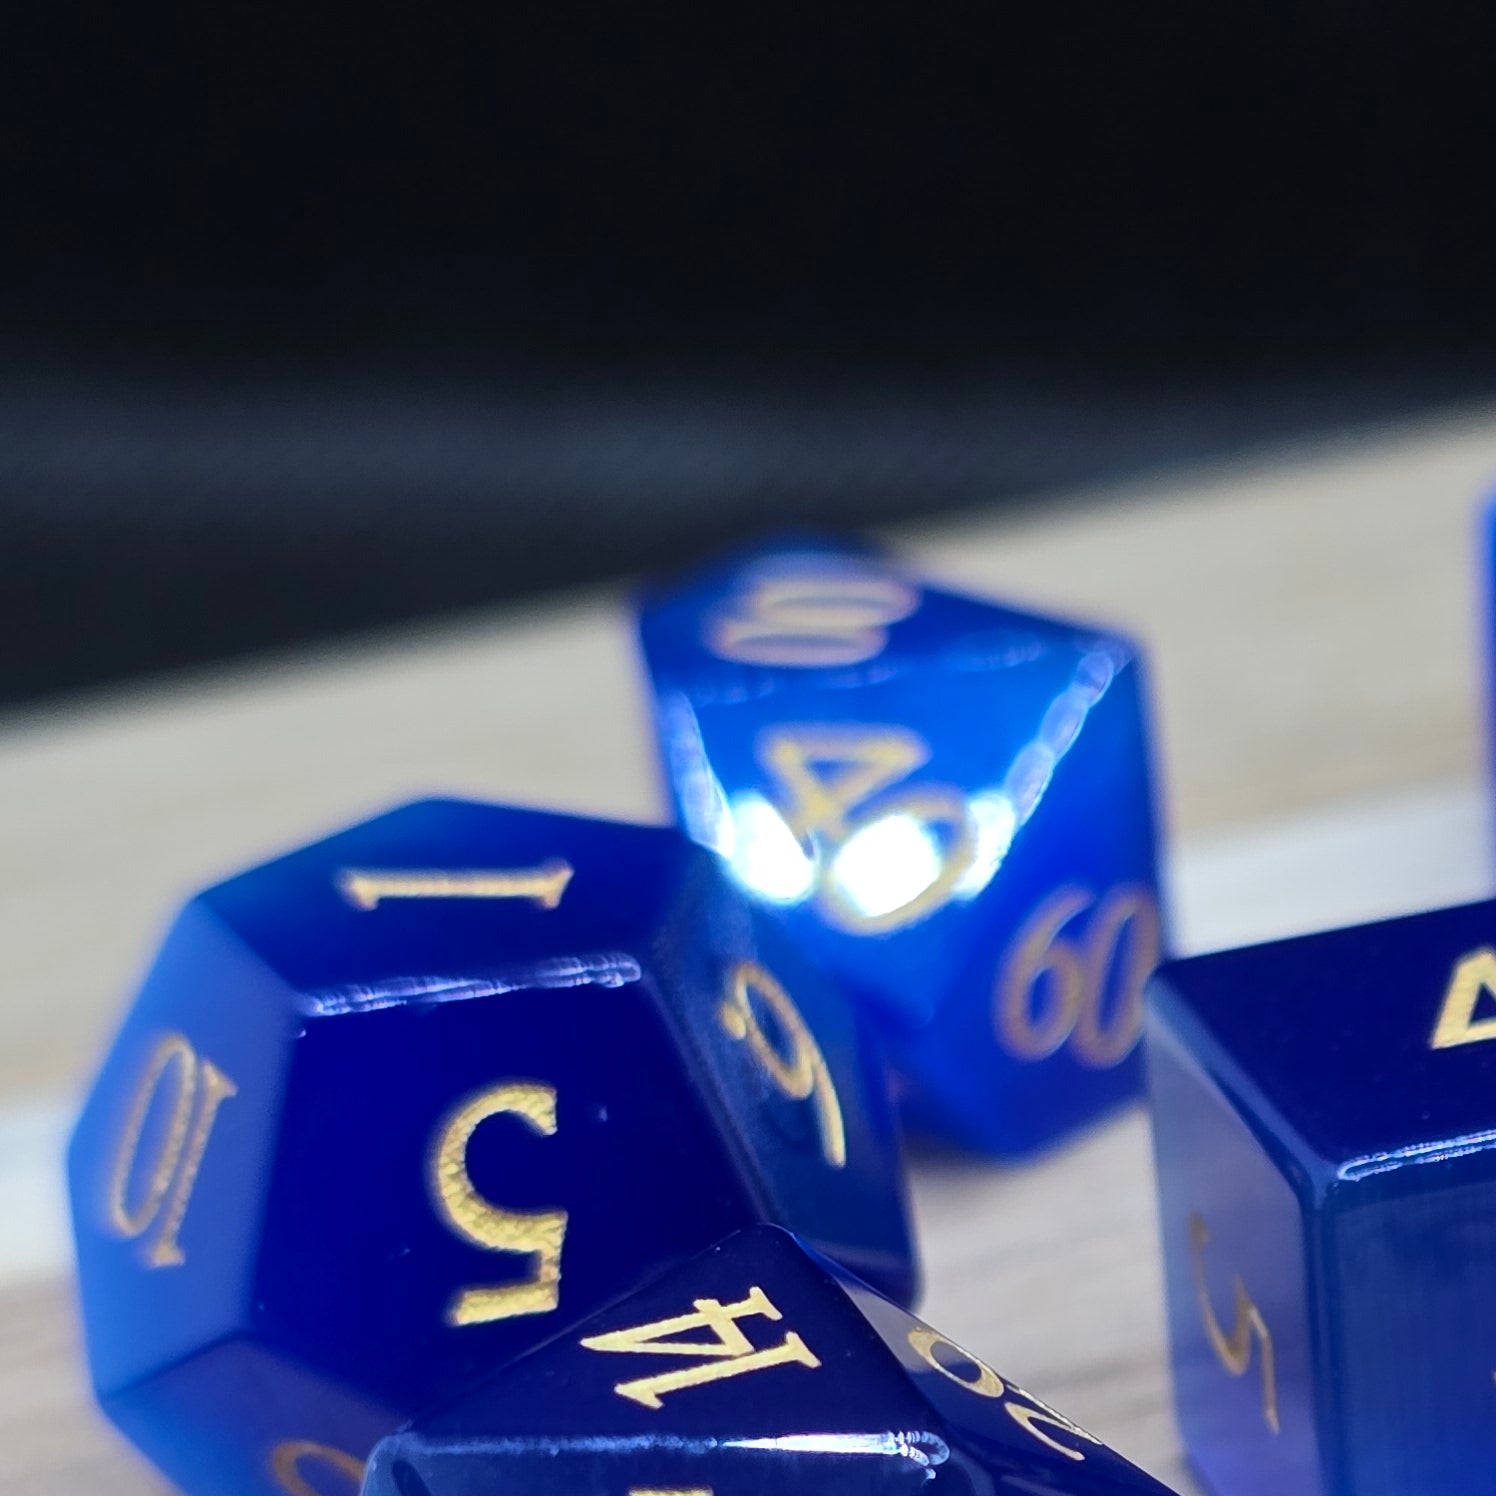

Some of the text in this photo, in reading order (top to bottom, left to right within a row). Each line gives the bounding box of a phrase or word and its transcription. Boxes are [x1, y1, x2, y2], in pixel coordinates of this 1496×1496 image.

[340, 860, 576, 912] 1
[998, 884, 1160, 1066] 60
[110, 1035, 238, 1268] 10
[434, 1082, 570, 1328] 5
[580, 1286, 822, 1410] 14
